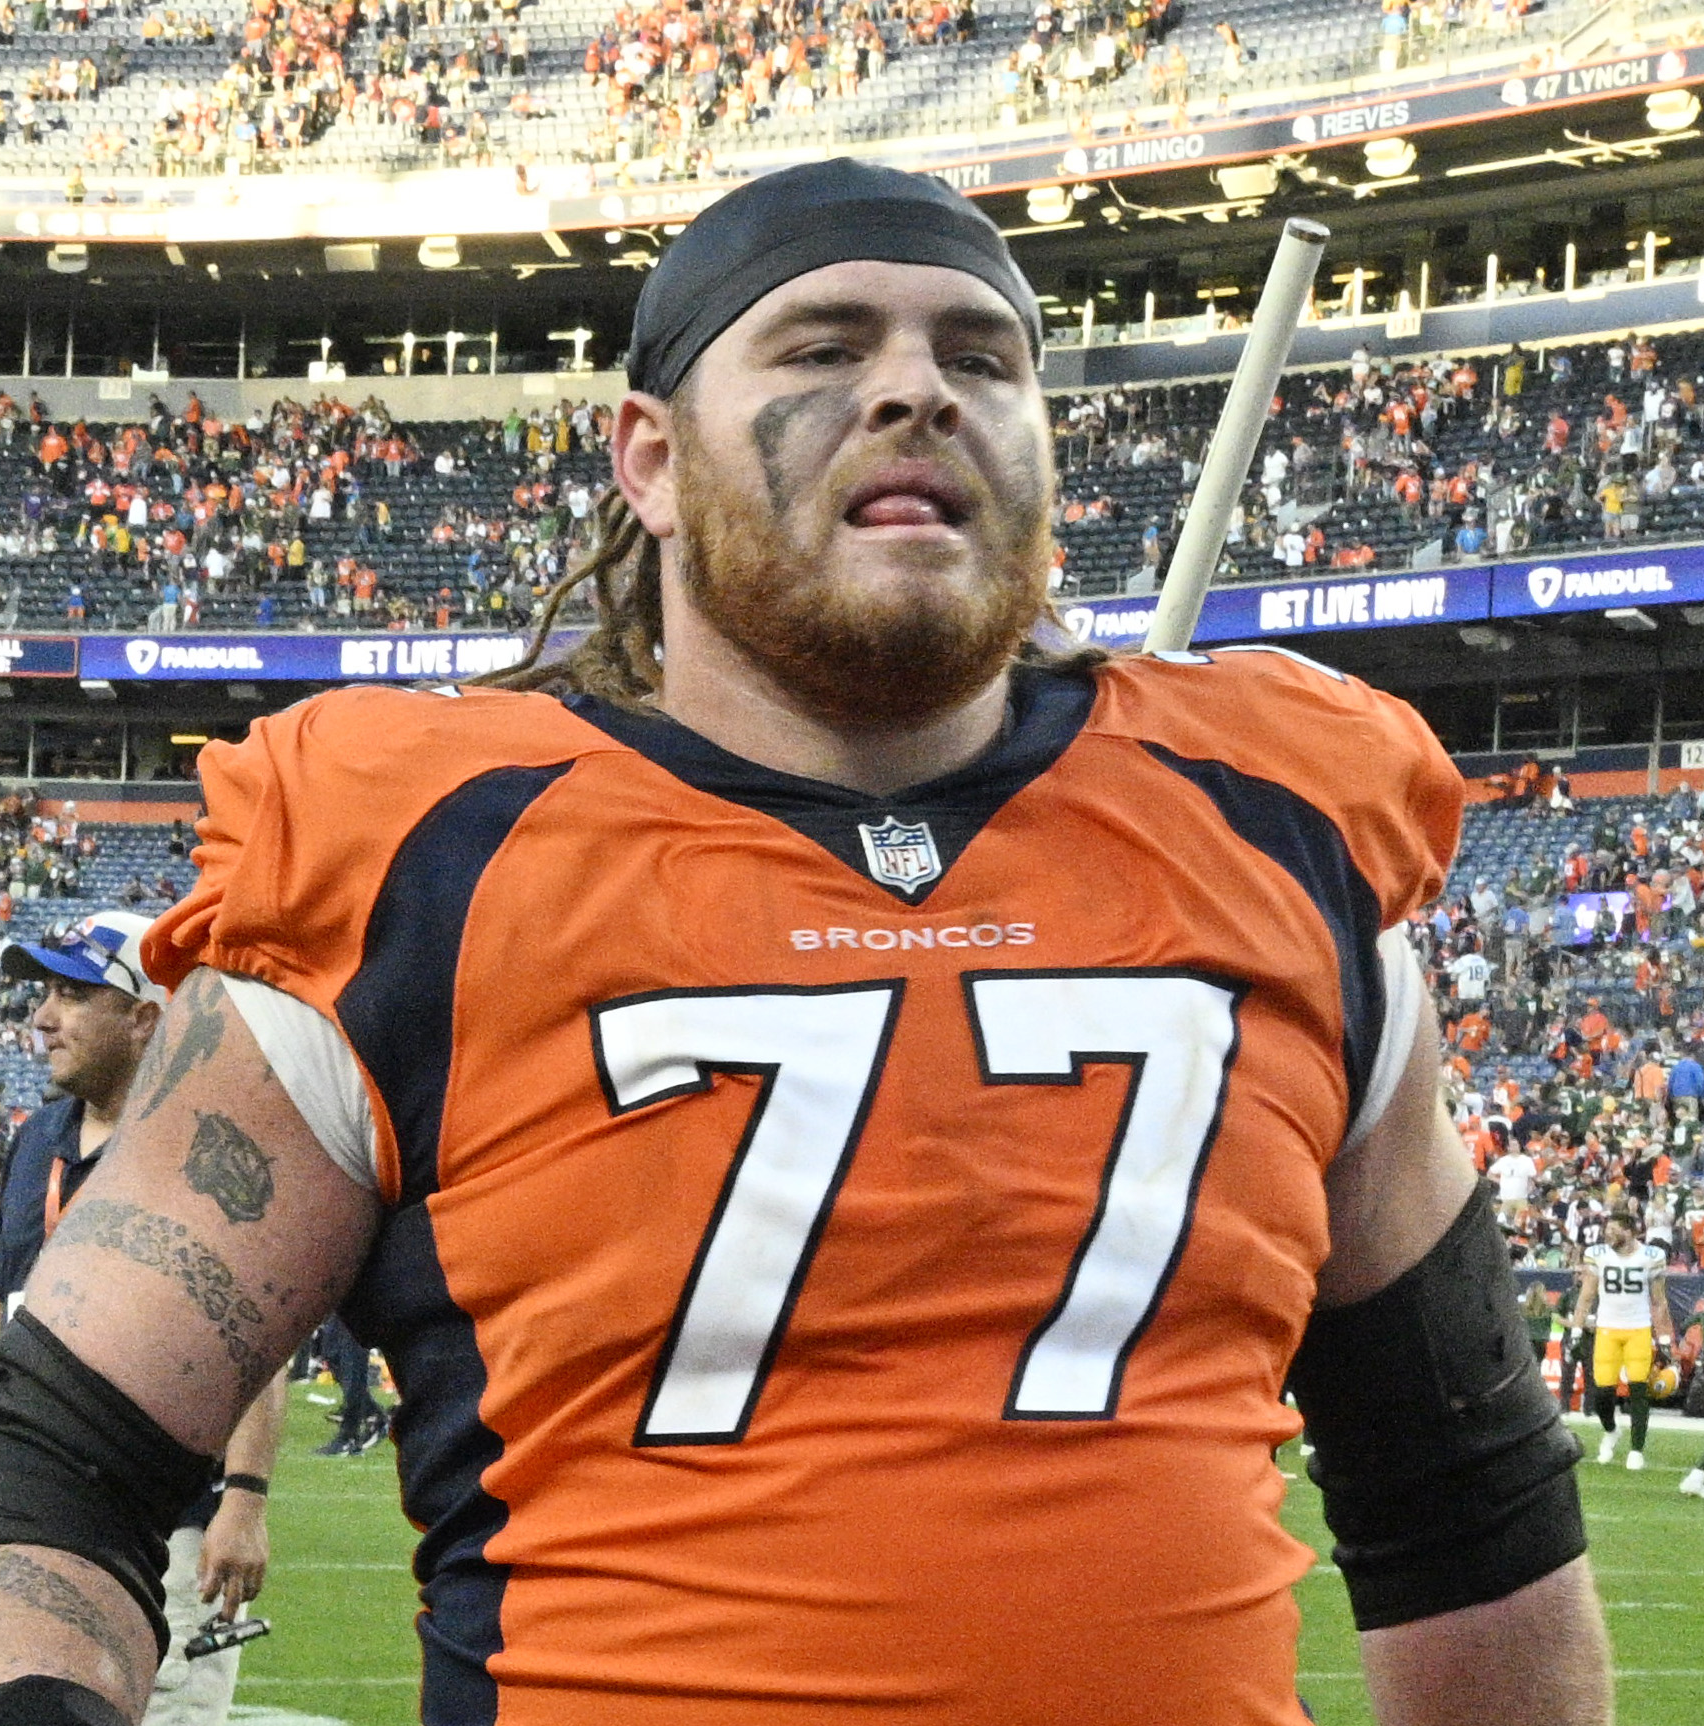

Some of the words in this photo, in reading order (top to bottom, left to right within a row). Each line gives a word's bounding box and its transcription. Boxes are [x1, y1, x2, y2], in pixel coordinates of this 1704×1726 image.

[1533, 75, 1561, 100] 47
[1567, 59, 1649, 96] LYNCH
[1321, 101, 1410, 138] REEVES
[1094, 149, 1118, 169] 21
[1123, 133, 1205, 167] MINGO
[1564, 565, 1673, 600] FANDUEL
[1260, 589, 1310, 630] BET
[1312, 583, 1370, 626] LIVE
[1374, 577, 1447, 620] NOW!
[1095, 609, 1156, 636] FAND
[161, 646, 264, 669] FANDUEL
[340, 640, 393, 674] BET
[397, 639, 453, 674] LIVE
[878, 845, 928, 878] NFL
[788, 920, 1037, 953] BRONCOS
[590, 967, 1252, 1447] 77
[1602, 1265, 1645, 1295] 85
